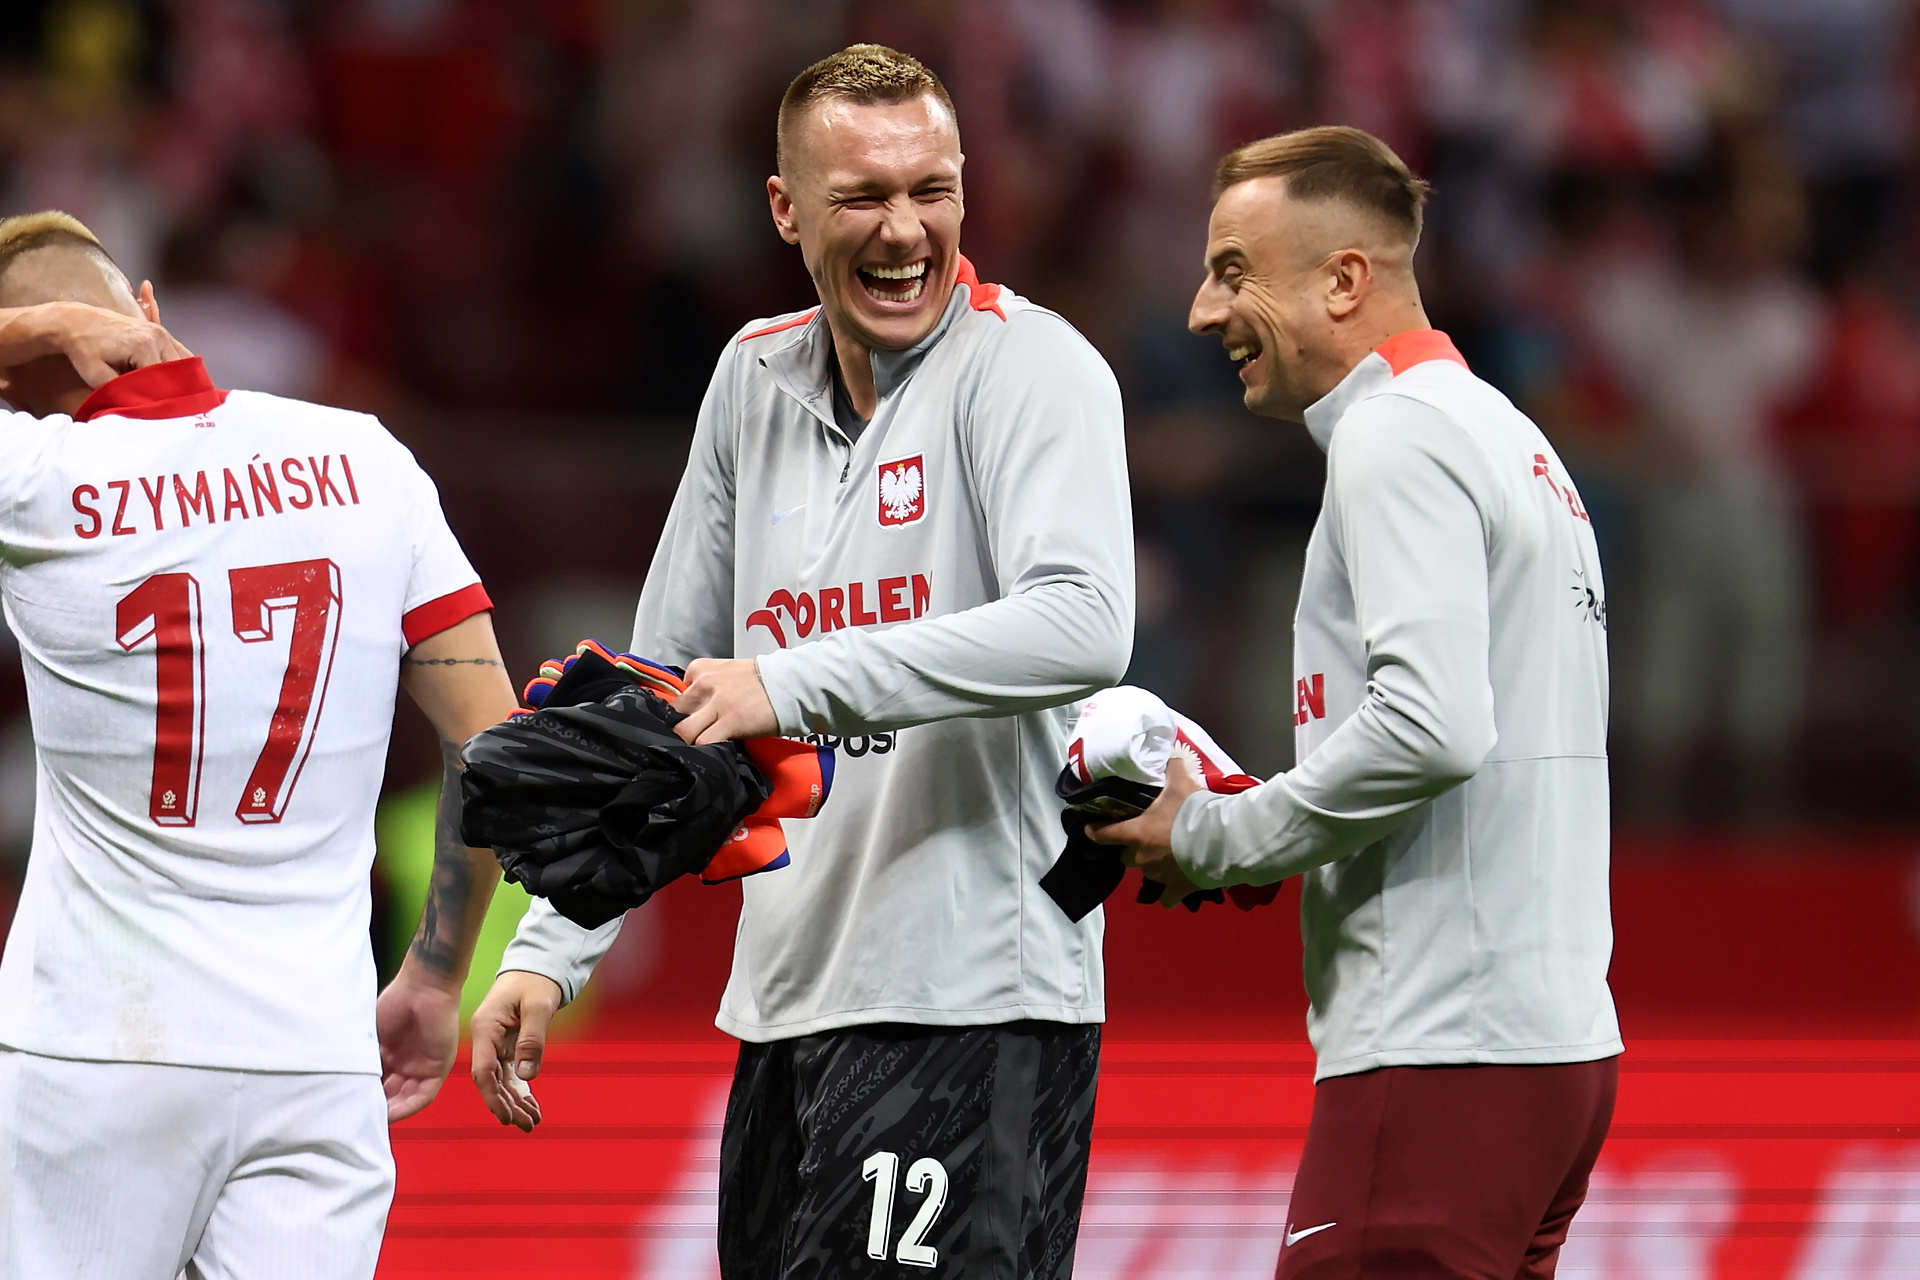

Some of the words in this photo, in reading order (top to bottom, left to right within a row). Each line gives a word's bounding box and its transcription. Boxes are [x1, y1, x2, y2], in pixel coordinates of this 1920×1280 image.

[71, 452, 361, 540] SZYMAŃSKI
[116, 558, 342, 828] 17
[1293, 673, 1326, 726] EN
[862, 1151, 948, 1269] 12
